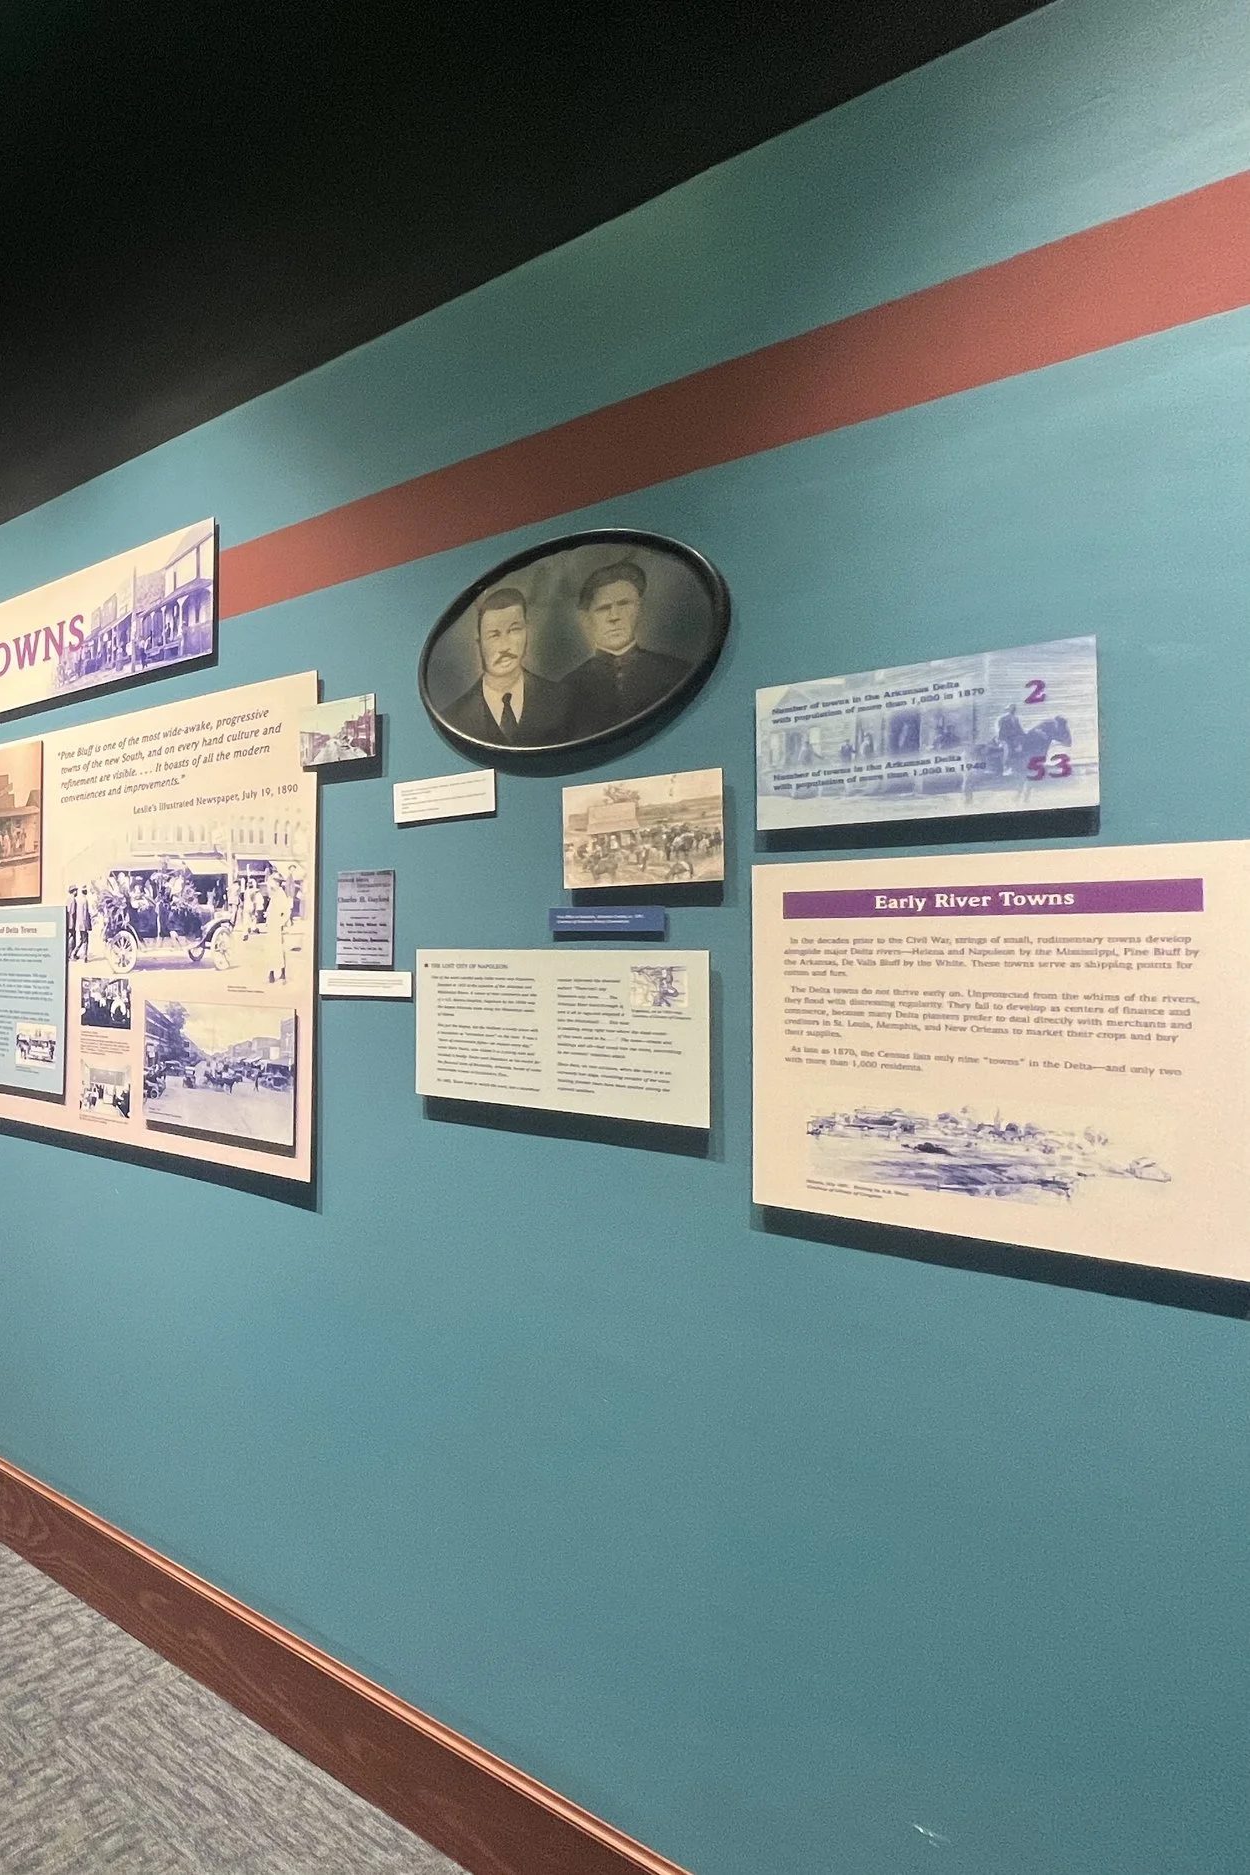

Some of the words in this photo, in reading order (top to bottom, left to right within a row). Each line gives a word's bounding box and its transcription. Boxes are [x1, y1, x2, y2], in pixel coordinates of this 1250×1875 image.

[771, 703, 807, 715] Number
[810, 701, 820, 709] of
[822, 699, 849, 708] towns
[853, 696, 861, 704] in
[865, 693, 880, 702] the
[884, 685, 929, 698] Arkansas
[933, 681, 960, 691] Delta
[1024, 679, 1046, 705] 2
[772, 716, 791, 725] with
[794, 709, 842, 723] population
[846, 706, 855, 714] of
[858, 703, 882, 713] more
[886, 699, 907, 707] than
[944, 691, 953, 699] in
[958, 687, 985, 698] 1870
[77, 745, 94, 756] Bluff
[95, 745, 101, 753] is
[103, 743, 116, 751] one
[118, 738, 127, 750] of
[128, 736, 140, 746] the
[142, 732, 161, 743] most
[163, 720, 213, 738] wide-awake,
[216, 709, 269, 729] progressive
[61, 765, 80, 774] towns
[83, 760, 91, 772] of
[92, 760, 103, 768] the
[105, 757, 120, 766] new
[122, 751, 145, 763] South,
[148, 747, 162, 757] and
[165, 746, 174, 754] on
[178, 740, 199, 751] every
[202, 733, 224, 747] hand
[226, 730, 259, 742] culture
[262, 723, 282, 735] and
[61, 776, 97, 790] refinement
[99, 774, 110, 782] are
[113, 768, 137, 780] visible.
[155, 763, 161, 772] It
[164, 758, 189, 771] boasts
[192, 754, 201, 768] of
[203, 753, 214, 763] all
[216, 751, 230, 761] the
[234, 745, 270, 759] modern
[773, 782, 793, 791] with
[796, 777, 844, 790] population
[847, 775, 856, 783] of
[887, 770, 908, 779] than
[945, 765, 955, 773] in
[774, 771, 809, 782] Number
[812, 769, 821, 777] of
[824, 766, 851, 775] towns
[867, 763, 882, 771] the
[885, 757, 931, 769] Arkansas
[935, 754, 962, 764] Delta
[1025, 753, 1071, 781] 53
[61, 790, 106, 803] conveniences
[108, 786, 122, 795] and
[133, 804, 157, 814] Leslie's
[159, 798, 194, 811] Illustrated
[196, 793, 240, 806] Newspaper,
[242, 790, 257, 800] July
[261, 788, 274, 797] 19,
[277, 784, 298, 795] 1890
[874, 895, 927, 912] Early
[934, 893, 992, 908] River
[999, 891, 1075, 907] Towns
[1037, 936, 1103, 945] rudimentary
[1146, 936, 1191, 945] develop
[1020, 948, 1031, 957] by
[1124, 948, 1149, 956] Pine
[1153, 948, 1180, 956] Bluff
[1186, 948, 1199, 958] by
[1085, 961, 1133, 970] shipping
[1176, 961, 1193, 969] for
[948, 1001, 971, 1010] They
[1006, 1004, 1046, 1013] develop
[1108, 1006, 1119, 1014] of
[1123, 1007, 1165, 1015] finance
[1169, 1008, 1190, 1016] and
[1061, 992, 1079, 1000] the
[1124, 993, 1135, 1001] of
[1140, 994, 1157, 1002] the
[1034, 1016, 1074, 1025] directly
[1077, 1018, 1102, 1026] with
[1107, 1019, 1166, 1028] merchants
[1171, 1021, 1192, 1029] and
[1097, 1032, 1126, 1040] crops
[1131, 1032, 1150, 1040] and
[1157, 1033, 1178, 1043] buy
[1130, 1066, 1155, 1076] only
